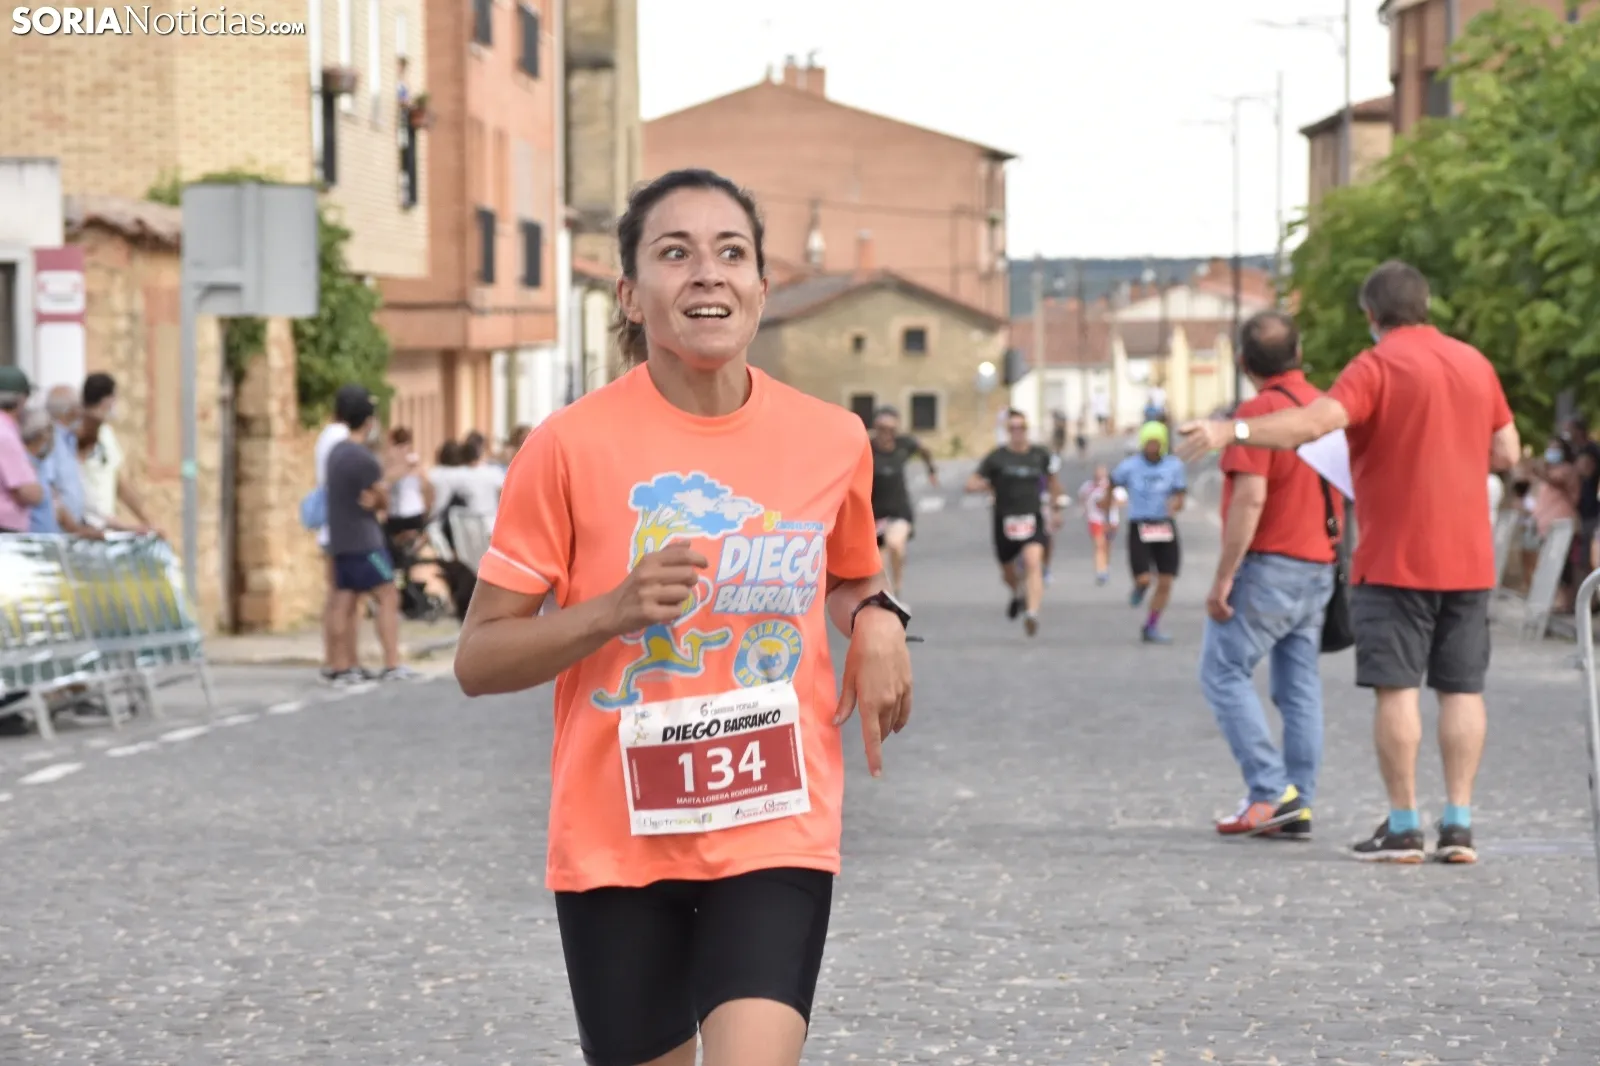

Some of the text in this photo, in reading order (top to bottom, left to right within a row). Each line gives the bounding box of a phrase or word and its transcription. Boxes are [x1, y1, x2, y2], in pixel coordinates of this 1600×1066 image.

[715, 534, 825, 585] DIEGO
[712, 583, 818, 615] BARRANCO
[662, 708, 781, 743] DIEGO BARRANCO
[678, 739, 766, 792] 134
[676, 796, 701, 805] MARTA
[731, 784, 768, 798] RODRIGUEZ
